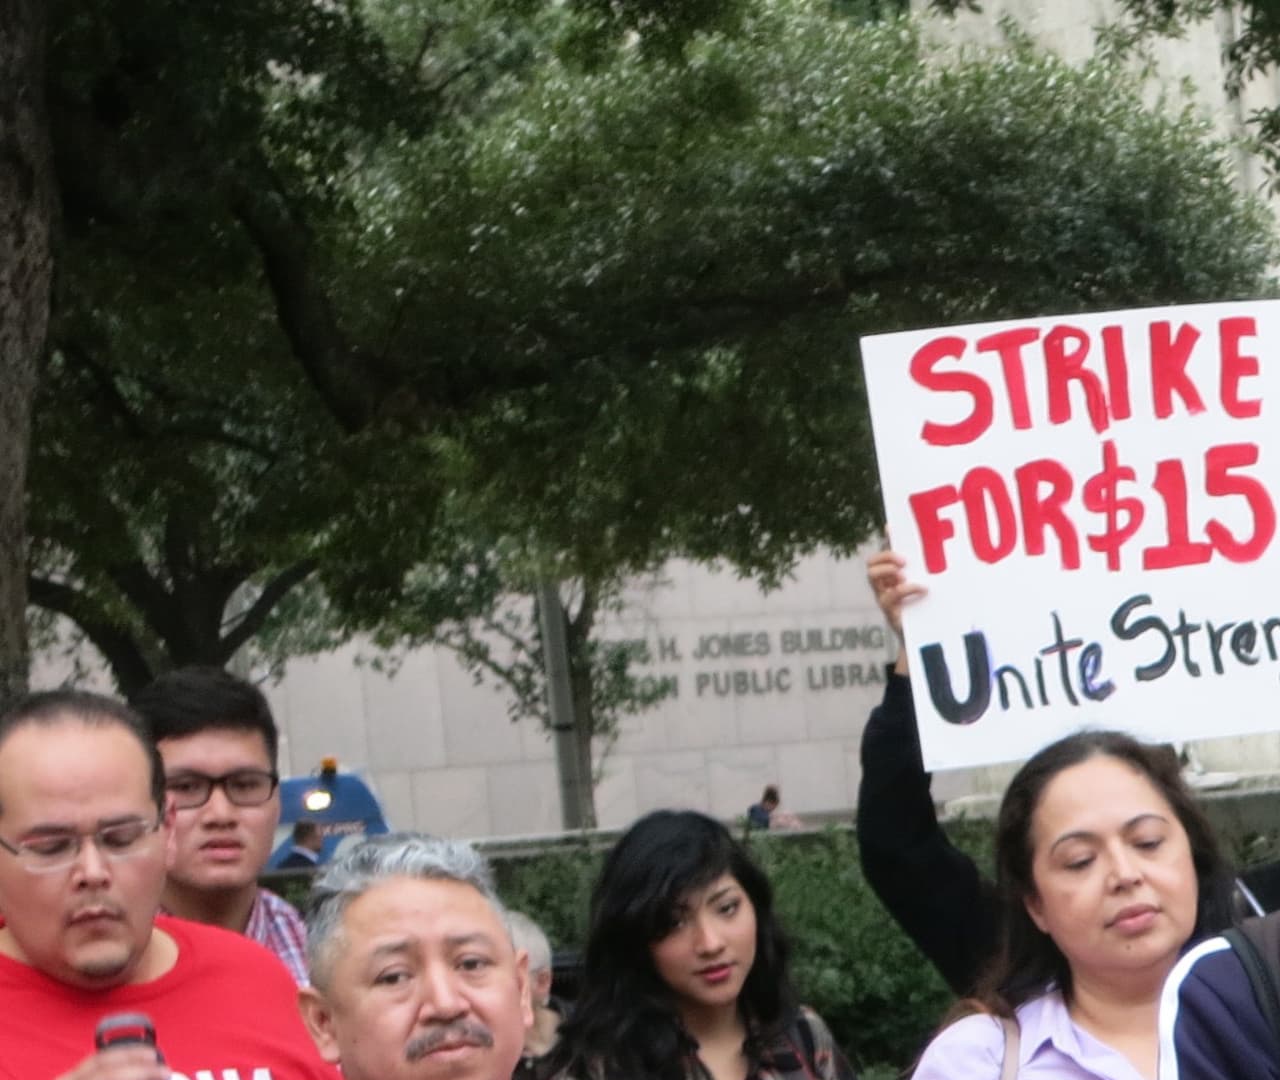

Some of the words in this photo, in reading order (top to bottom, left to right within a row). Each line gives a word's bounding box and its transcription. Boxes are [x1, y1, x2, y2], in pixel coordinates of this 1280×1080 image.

[908, 316, 1264, 448] STRIKE
[692, 630, 772, 660] JONES
[780, 625, 886, 655] BUILDING
[695, 667, 792, 697] PUBLIC
[806, 660, 889, 691] LIBRA
[919, 611, 1118, 726] Unite
